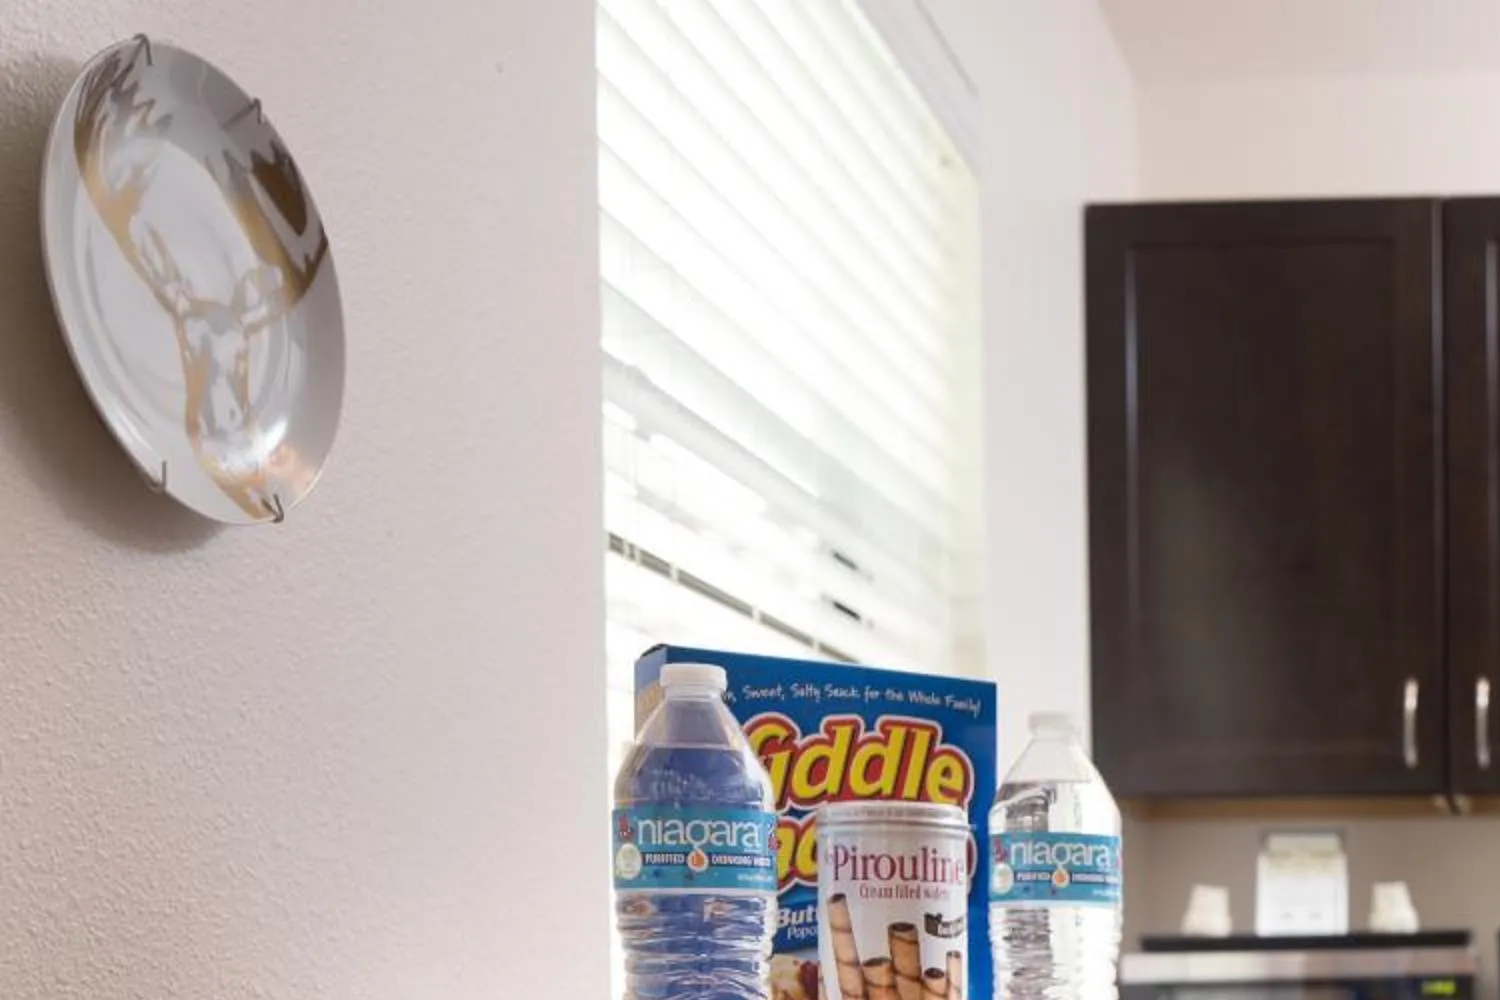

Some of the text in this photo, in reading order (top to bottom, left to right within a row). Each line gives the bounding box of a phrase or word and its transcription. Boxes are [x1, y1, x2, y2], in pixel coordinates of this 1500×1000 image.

[864, 685, 879, 703] for
[638, 819, 762, 853] niagara
[1010, 841, 1111, 869] niagara
